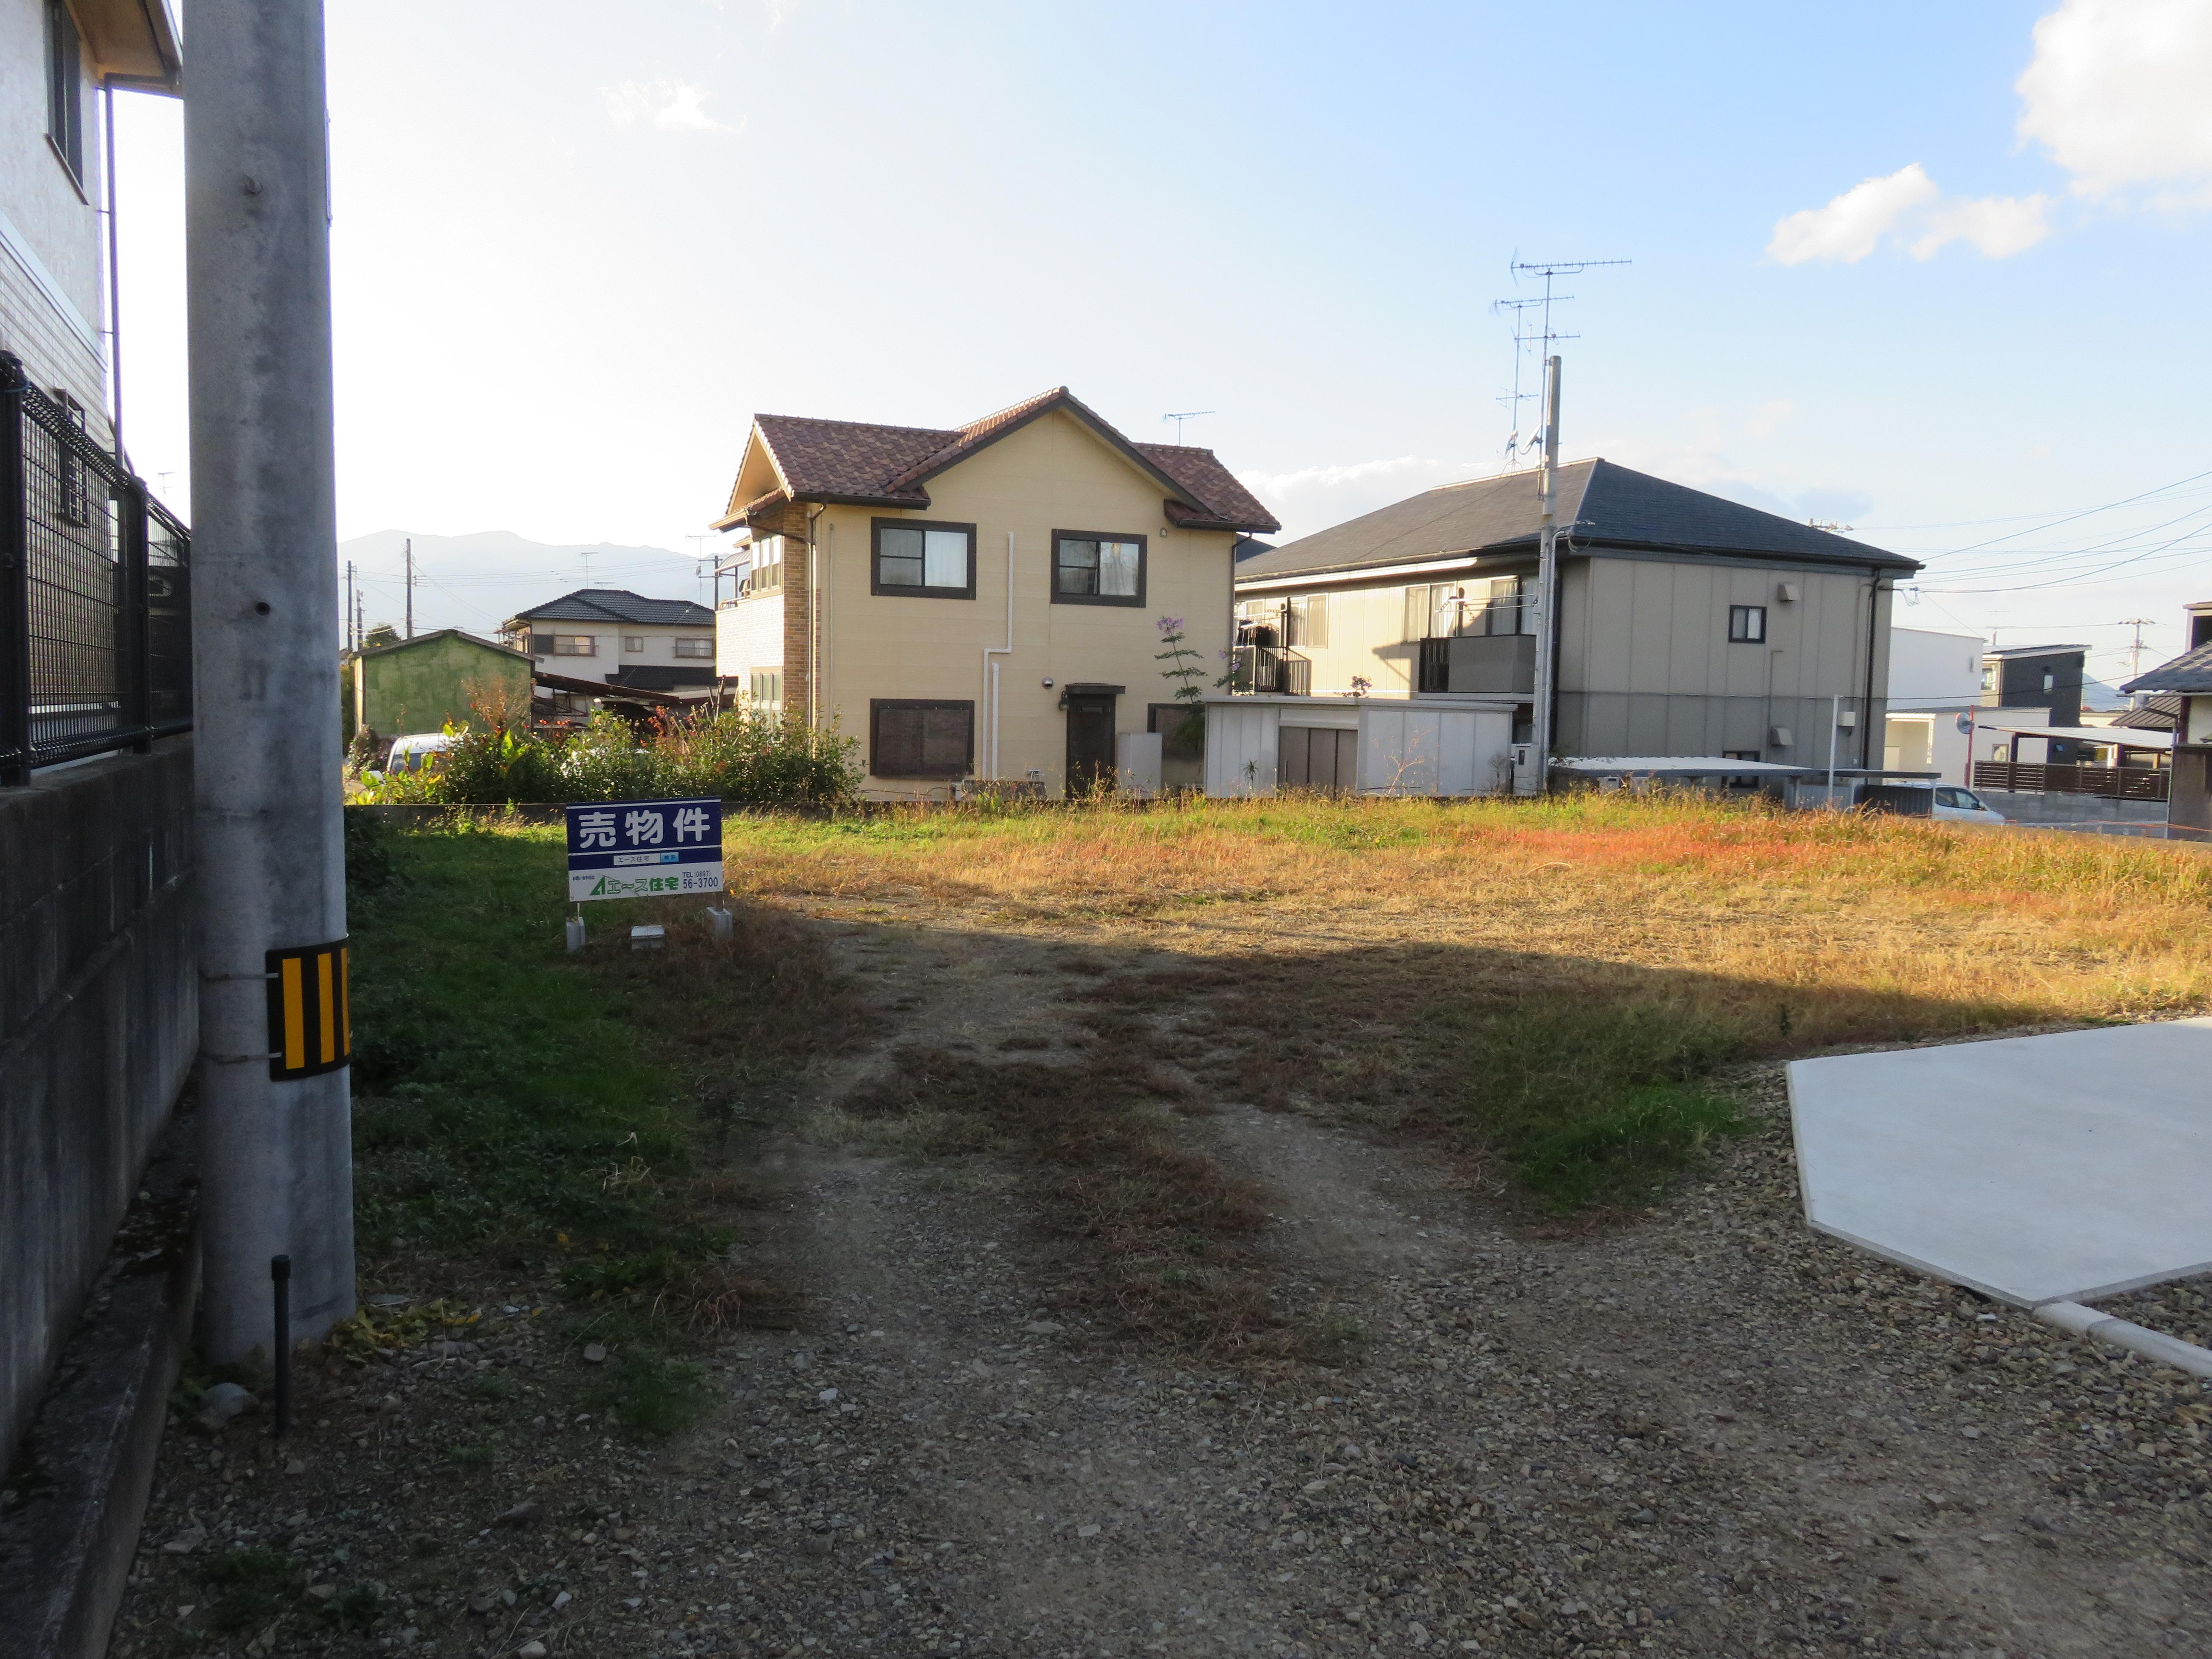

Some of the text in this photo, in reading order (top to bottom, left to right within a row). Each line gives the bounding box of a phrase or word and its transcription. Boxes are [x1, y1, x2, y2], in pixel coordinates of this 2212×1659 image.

[578, 807, 710, 849] 売物件
[607, 876, 678, 894] エース住宅
[683, 877, 718, 889] 56-3700
